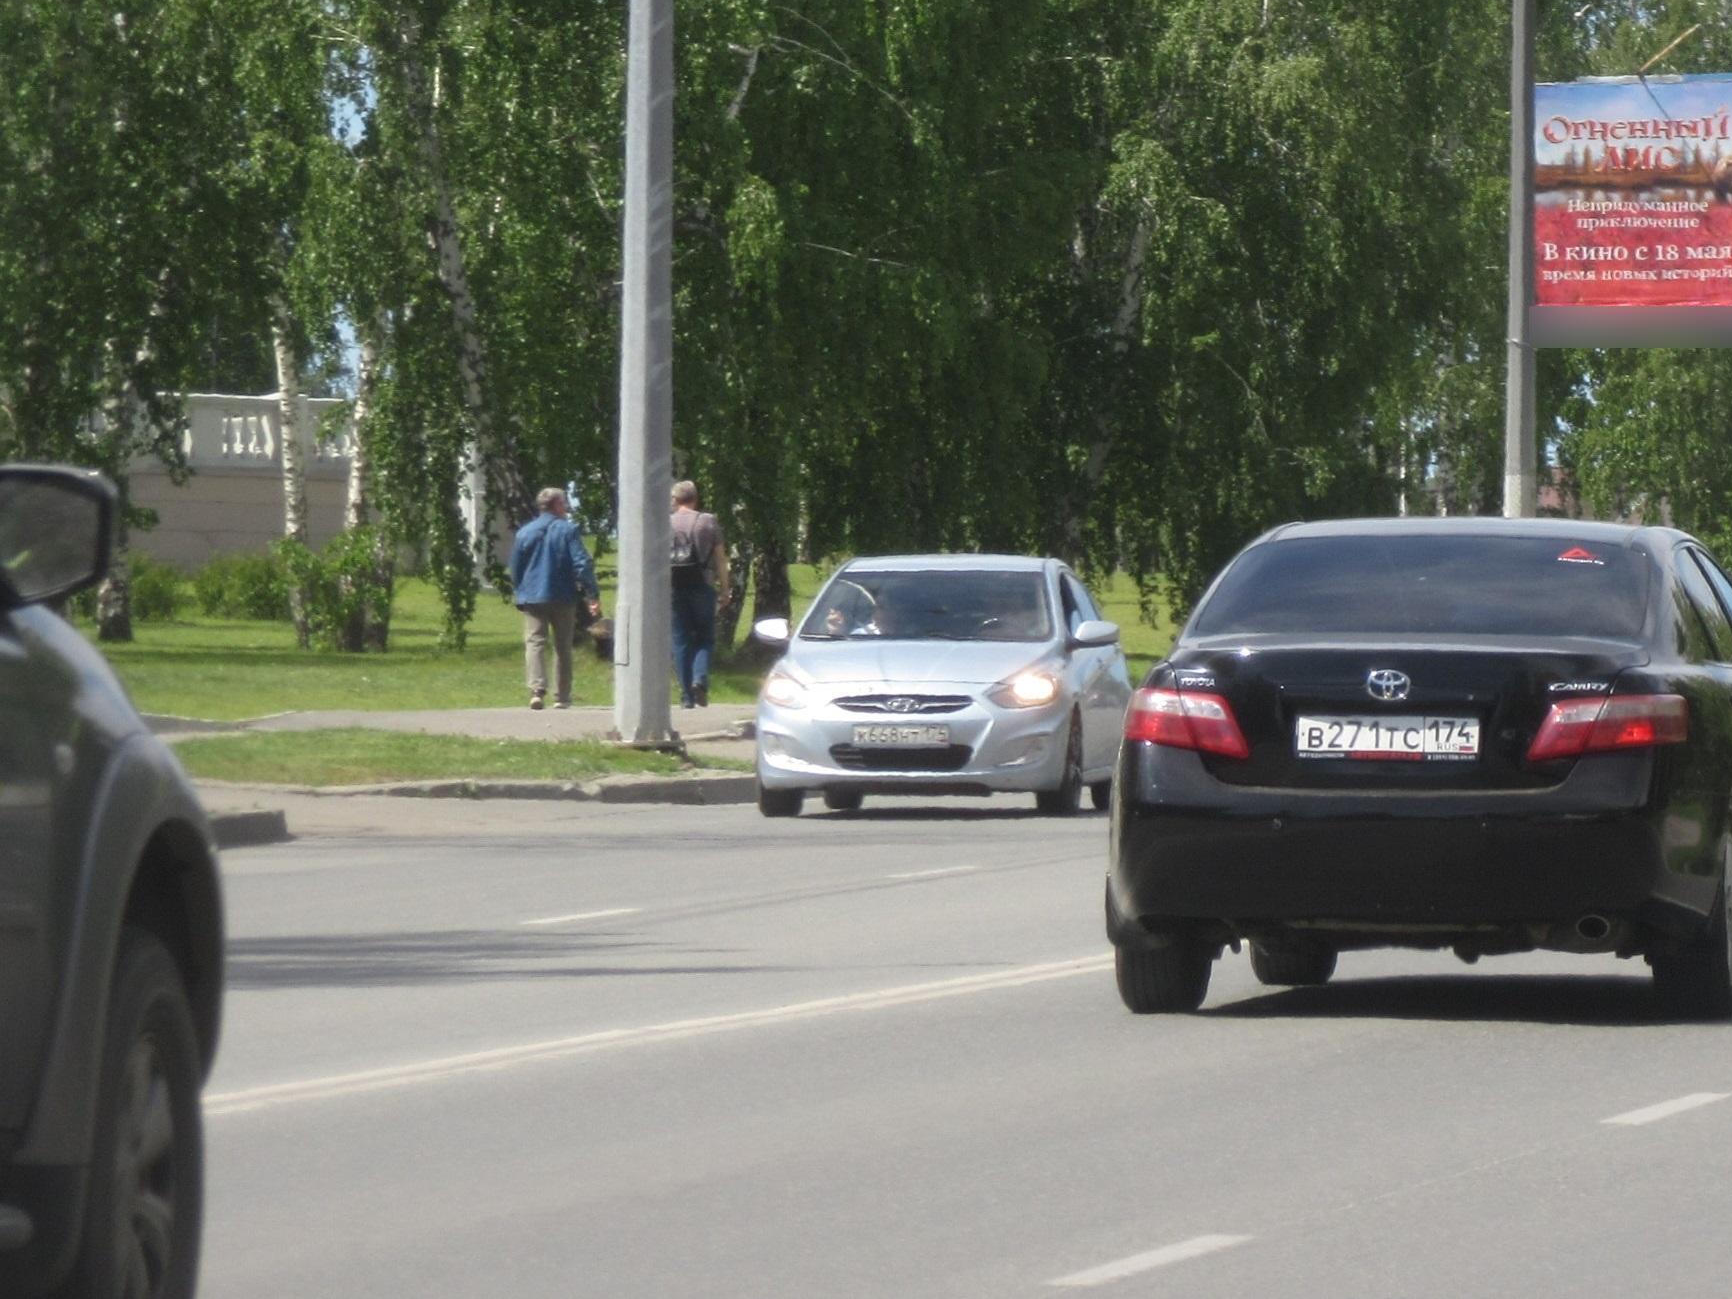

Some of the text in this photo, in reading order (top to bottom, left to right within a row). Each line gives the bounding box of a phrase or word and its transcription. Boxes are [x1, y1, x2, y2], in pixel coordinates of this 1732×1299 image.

[1567, 199, 1709, 214] Непридуманное
[1576, 217, 1700, 230] приключение
[1543, 243, 1732, 261] В кино с 18 мая
[1543, 269, 1596, 283] время
[1602, 269, 1657, 281] новых
[1180, 677, 1216, 687] TOYOTA
[1427, 719, 1471, 744] 174
